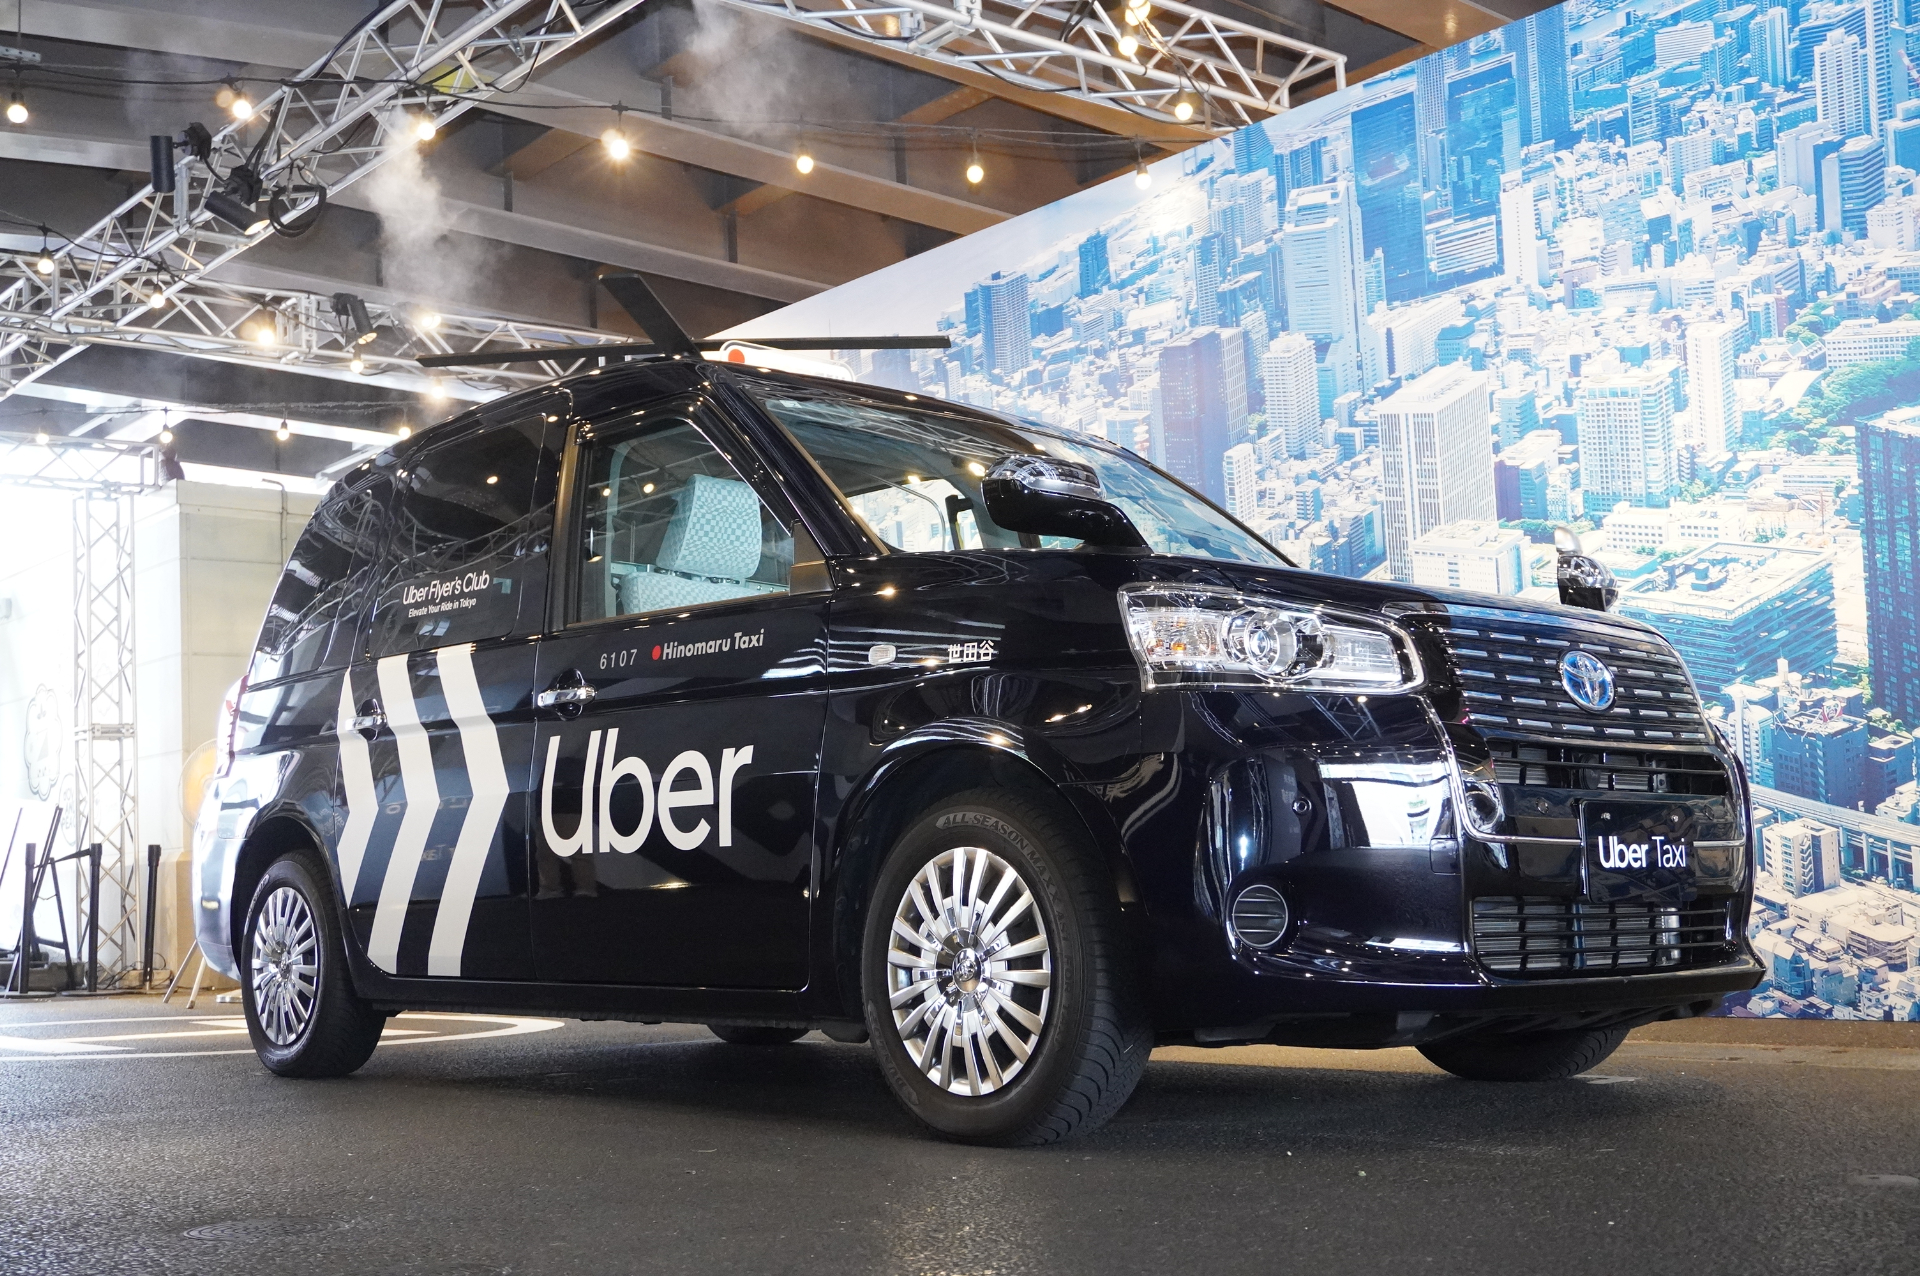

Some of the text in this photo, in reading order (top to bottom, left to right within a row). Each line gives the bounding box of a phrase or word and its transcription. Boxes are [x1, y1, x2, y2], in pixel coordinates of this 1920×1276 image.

[402, 570, 490, 605] Uber Flyer's Club
[408, 597, 477, 618] Elevate Your Ride in Tokyo
[599, 649, 638, 670] 6107
[662, 628, 765, 661] Hinomaru Taxi
[947, 640, 995, 664] 世田谷
[541, 727, 754, 858] Uber
[1598, 835, 1687, 869] Uber Taxi
